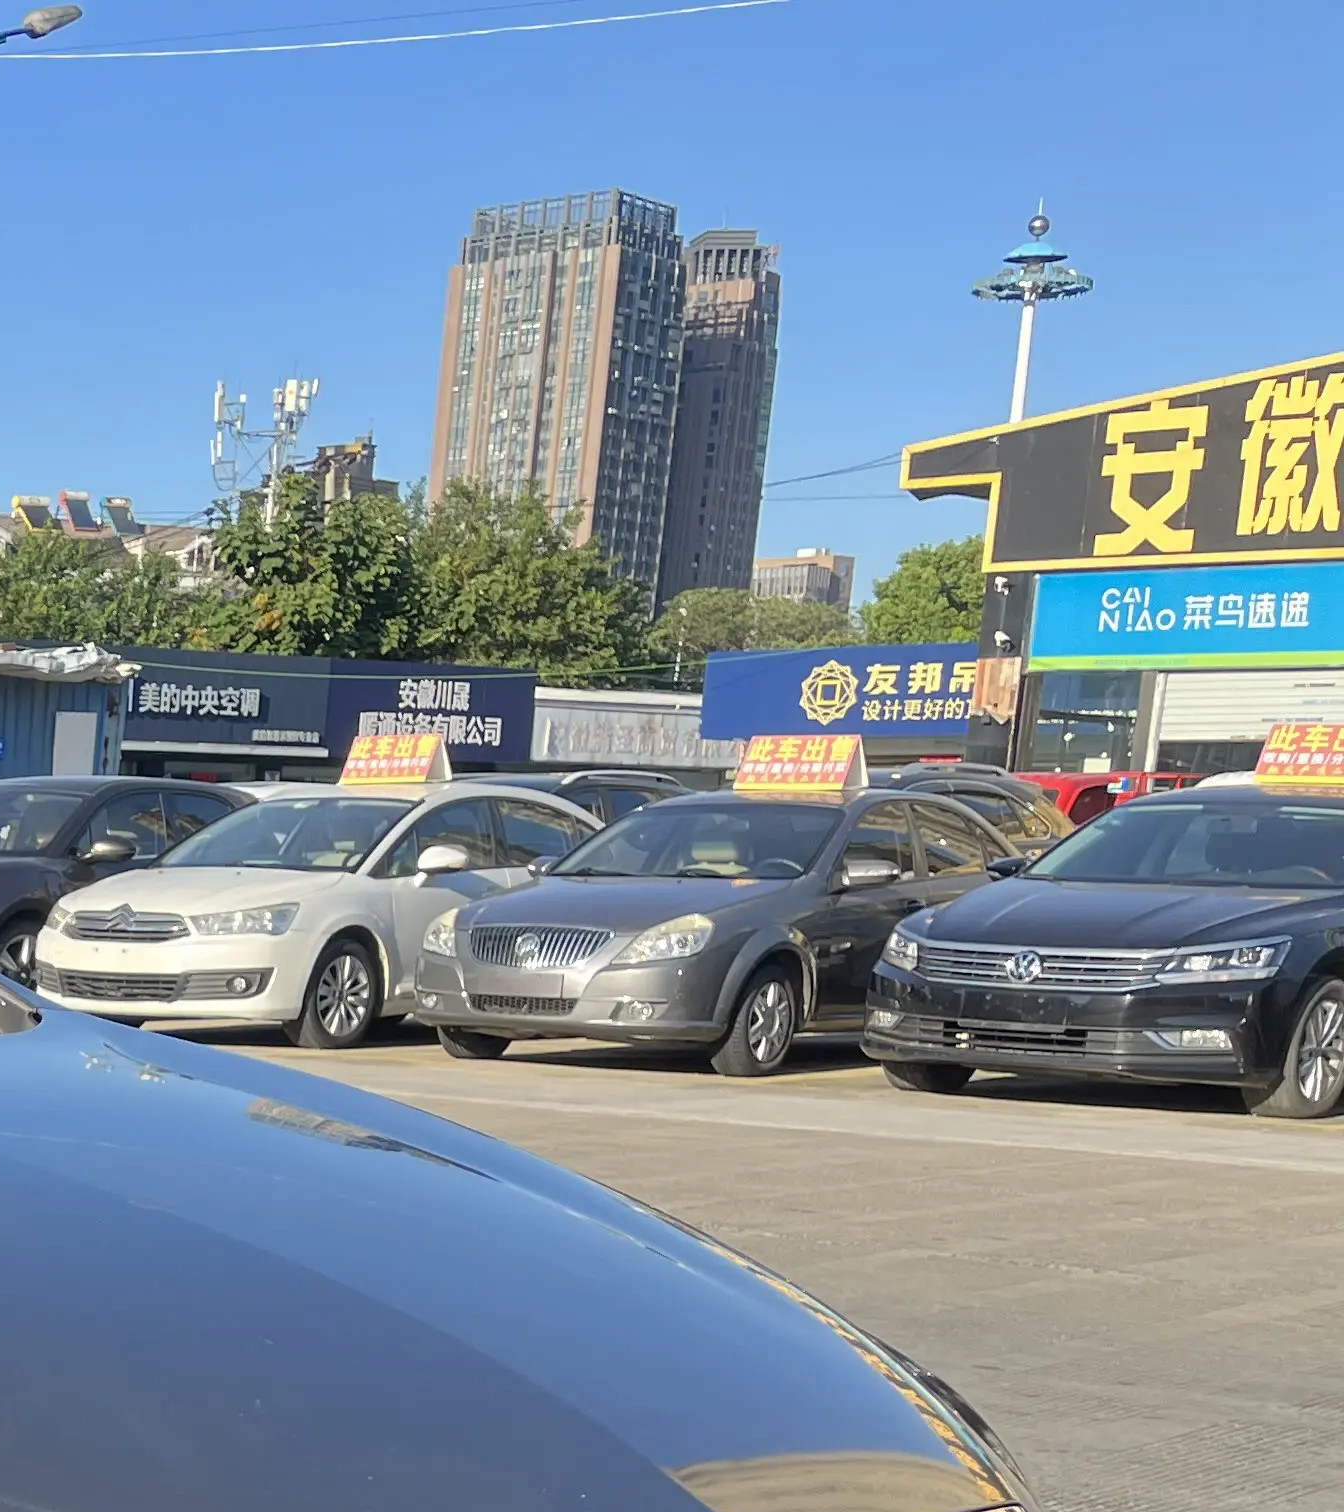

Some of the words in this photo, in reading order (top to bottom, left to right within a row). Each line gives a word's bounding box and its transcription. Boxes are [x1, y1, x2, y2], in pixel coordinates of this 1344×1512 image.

[1093, 372, 1344, 556] 安徽
[1102, 586, 1152, 610] CAI
[1183, 591, 1311, 631] 菜鸟速递
[139, 682, 261, 718] 美的中央空调
[358, 711, 503, 747] 暖通设备有限公司
[747, 736, 855, 762] 此车出售
